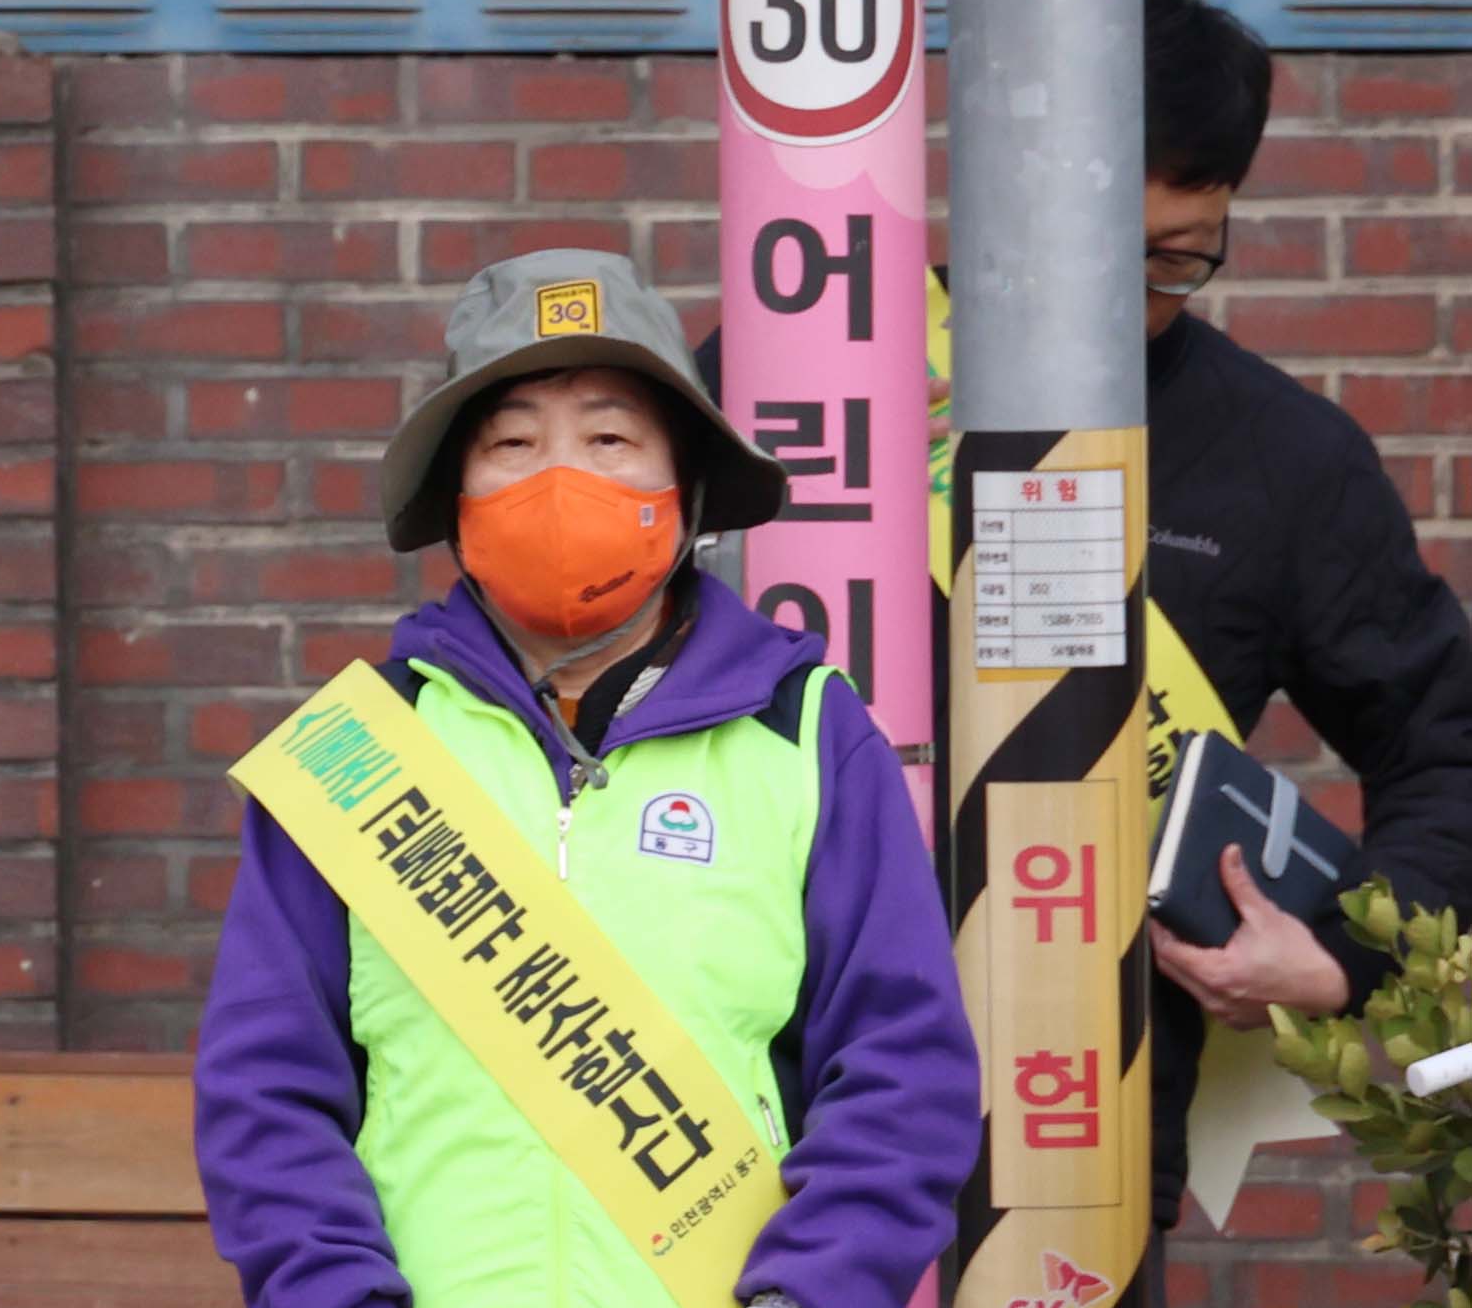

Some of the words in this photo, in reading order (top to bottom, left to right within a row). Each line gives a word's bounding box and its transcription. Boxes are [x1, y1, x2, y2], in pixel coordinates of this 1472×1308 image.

[548, 300, 587, 324] 30
[358, 785, 527, 965] 교통법규
[494, 943, 715, 1192] 준수합시다
[1012, 843, 1099, 1149] 위험
[669, 1174, 739, 1241] 인천광역시
[733, 1145, 761, 1181] 동구
